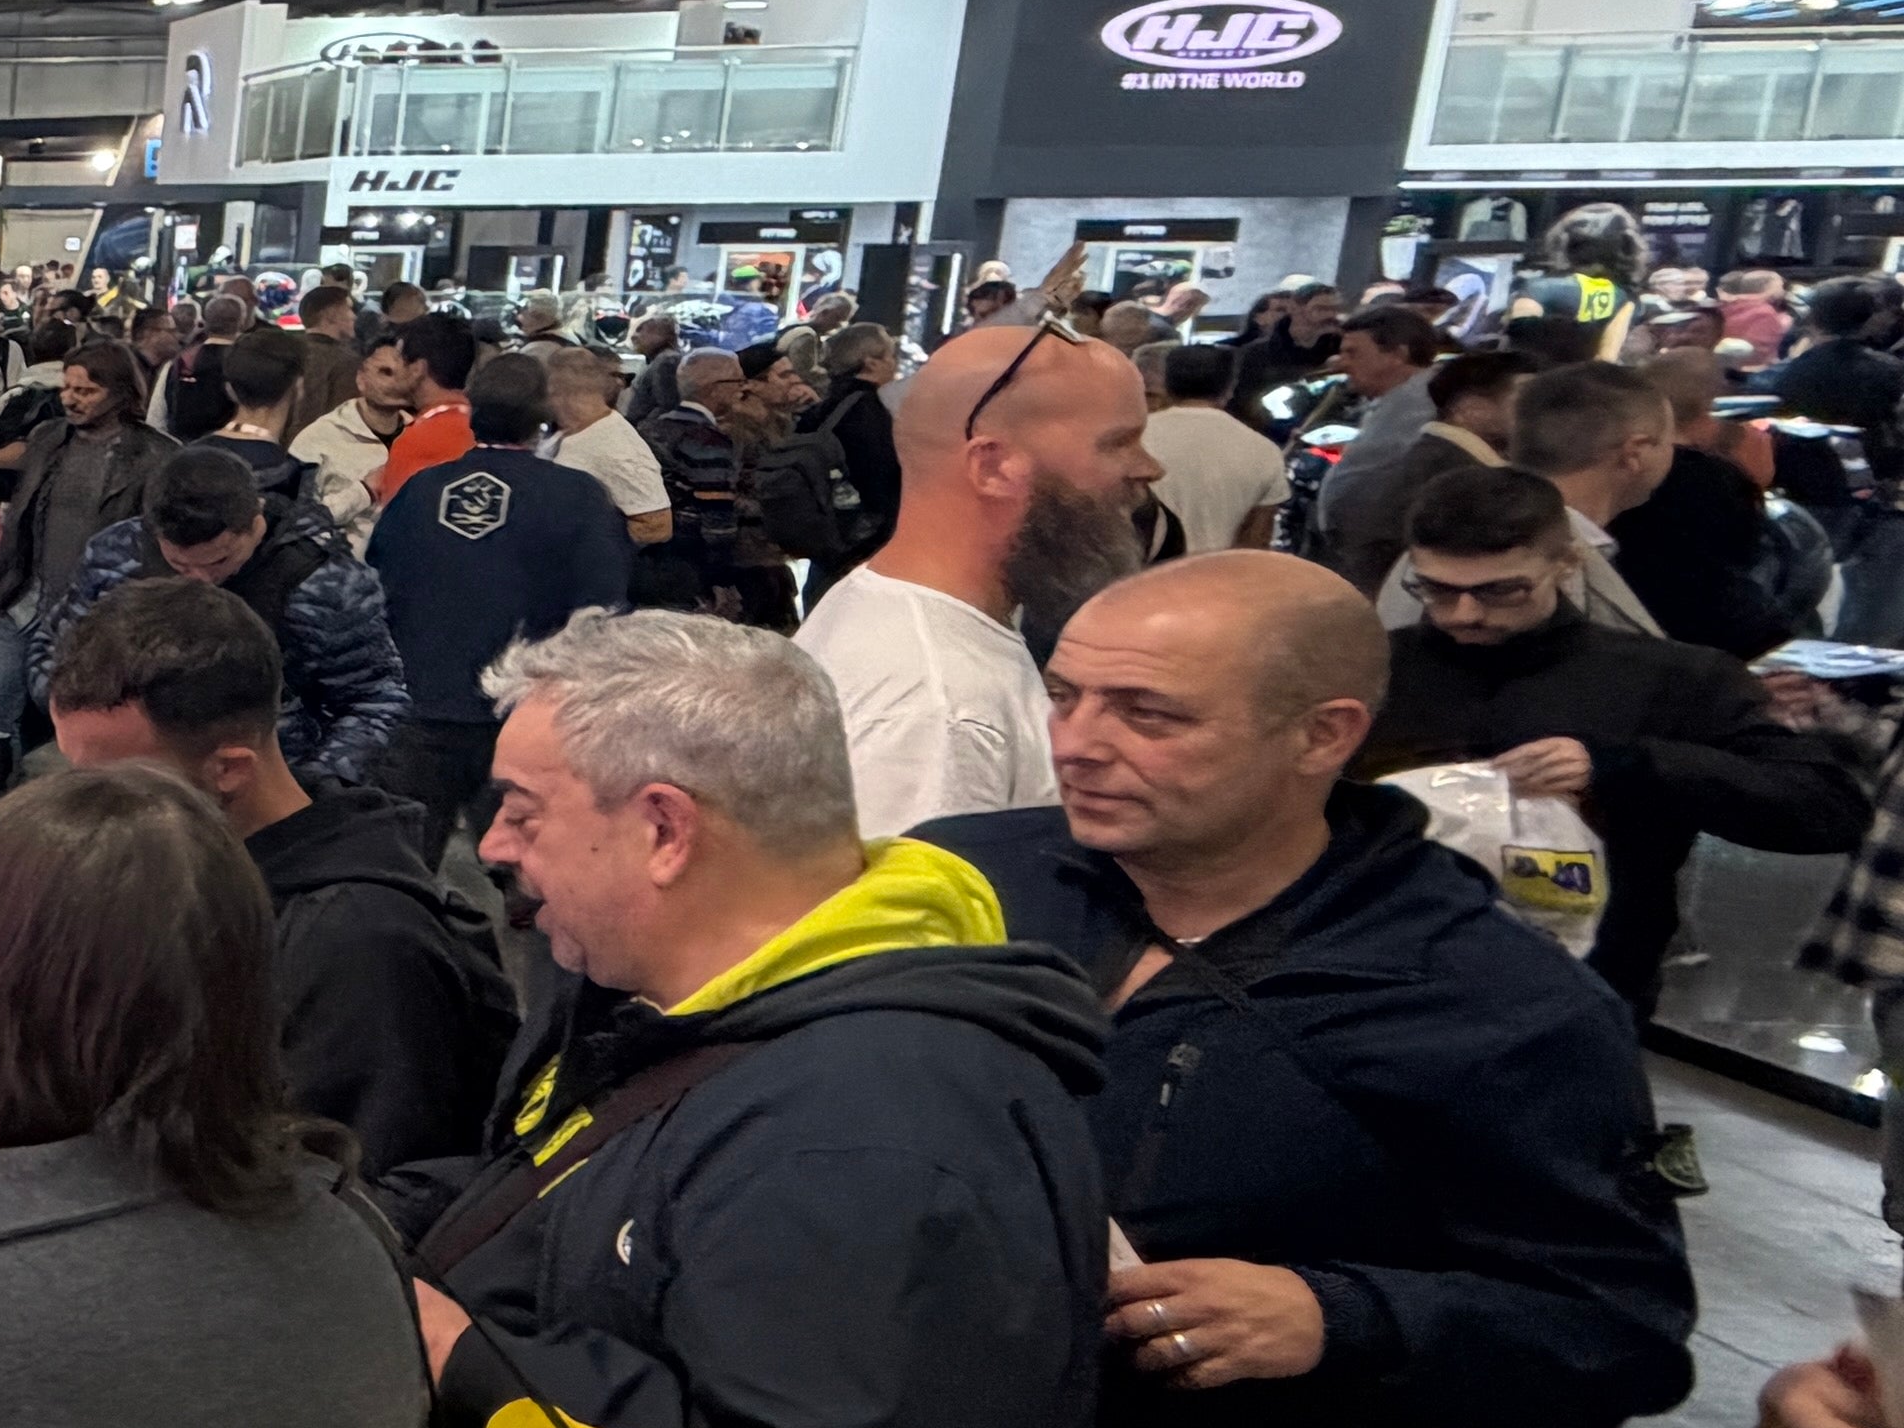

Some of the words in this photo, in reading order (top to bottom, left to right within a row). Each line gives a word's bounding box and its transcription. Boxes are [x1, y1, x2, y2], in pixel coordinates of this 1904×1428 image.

[1131, 13, 1312, 50] HJC
[1152, 73, 1176, 89] IN
[1177, 72, 1221, 89] THE
[1223, 71, 1306, 89] WORLD
[349, 170, 461, 192] HJC
